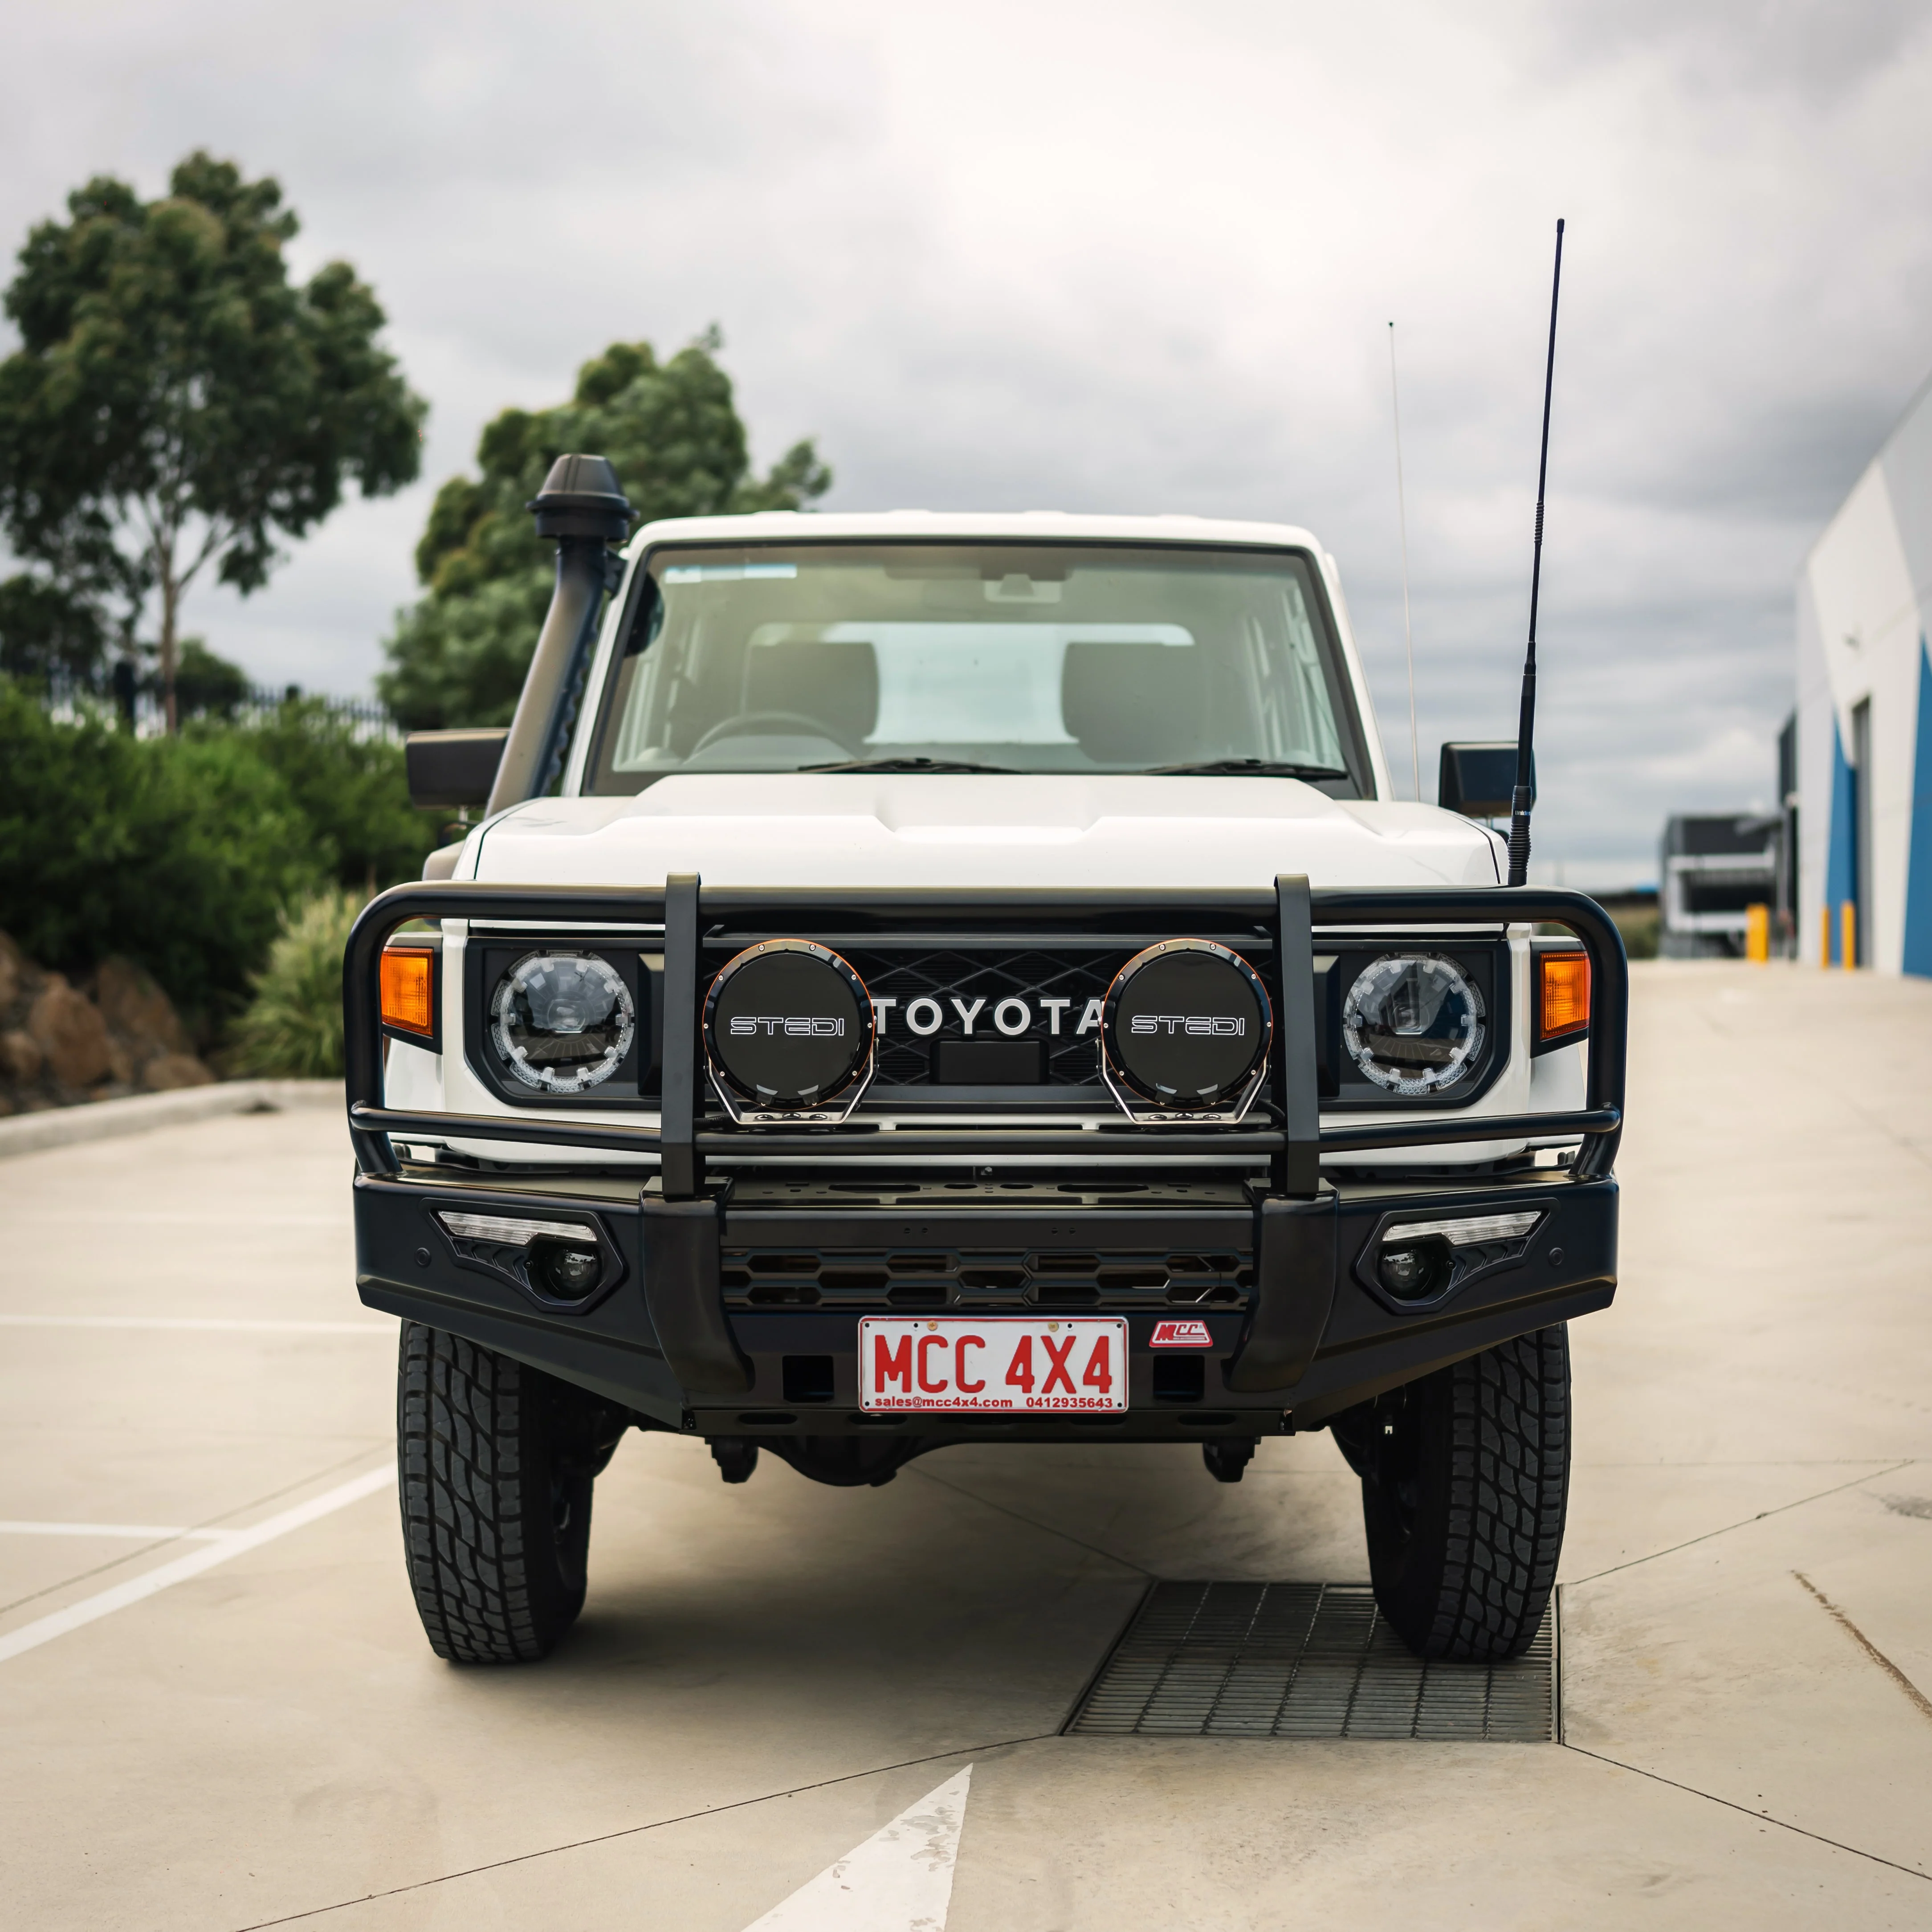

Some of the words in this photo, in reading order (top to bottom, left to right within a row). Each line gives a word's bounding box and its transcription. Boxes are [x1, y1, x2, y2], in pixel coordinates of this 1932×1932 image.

[870, 998, 1102, 1035] TOYOTA
[1132, 1015, 1245, 1035] STEDI
[731, 1017, 844, 1036] STEDI
[1155, 1324, 1205, 1341] MCC
[875, 1335, 986, 1393] MCC
[1005, 1335, 1113, 1394] 4X4
[875, 1396, 1013, 1407] sales@mcc4x4.com
[1026, 1397, 1113, 1408] 0412935643
